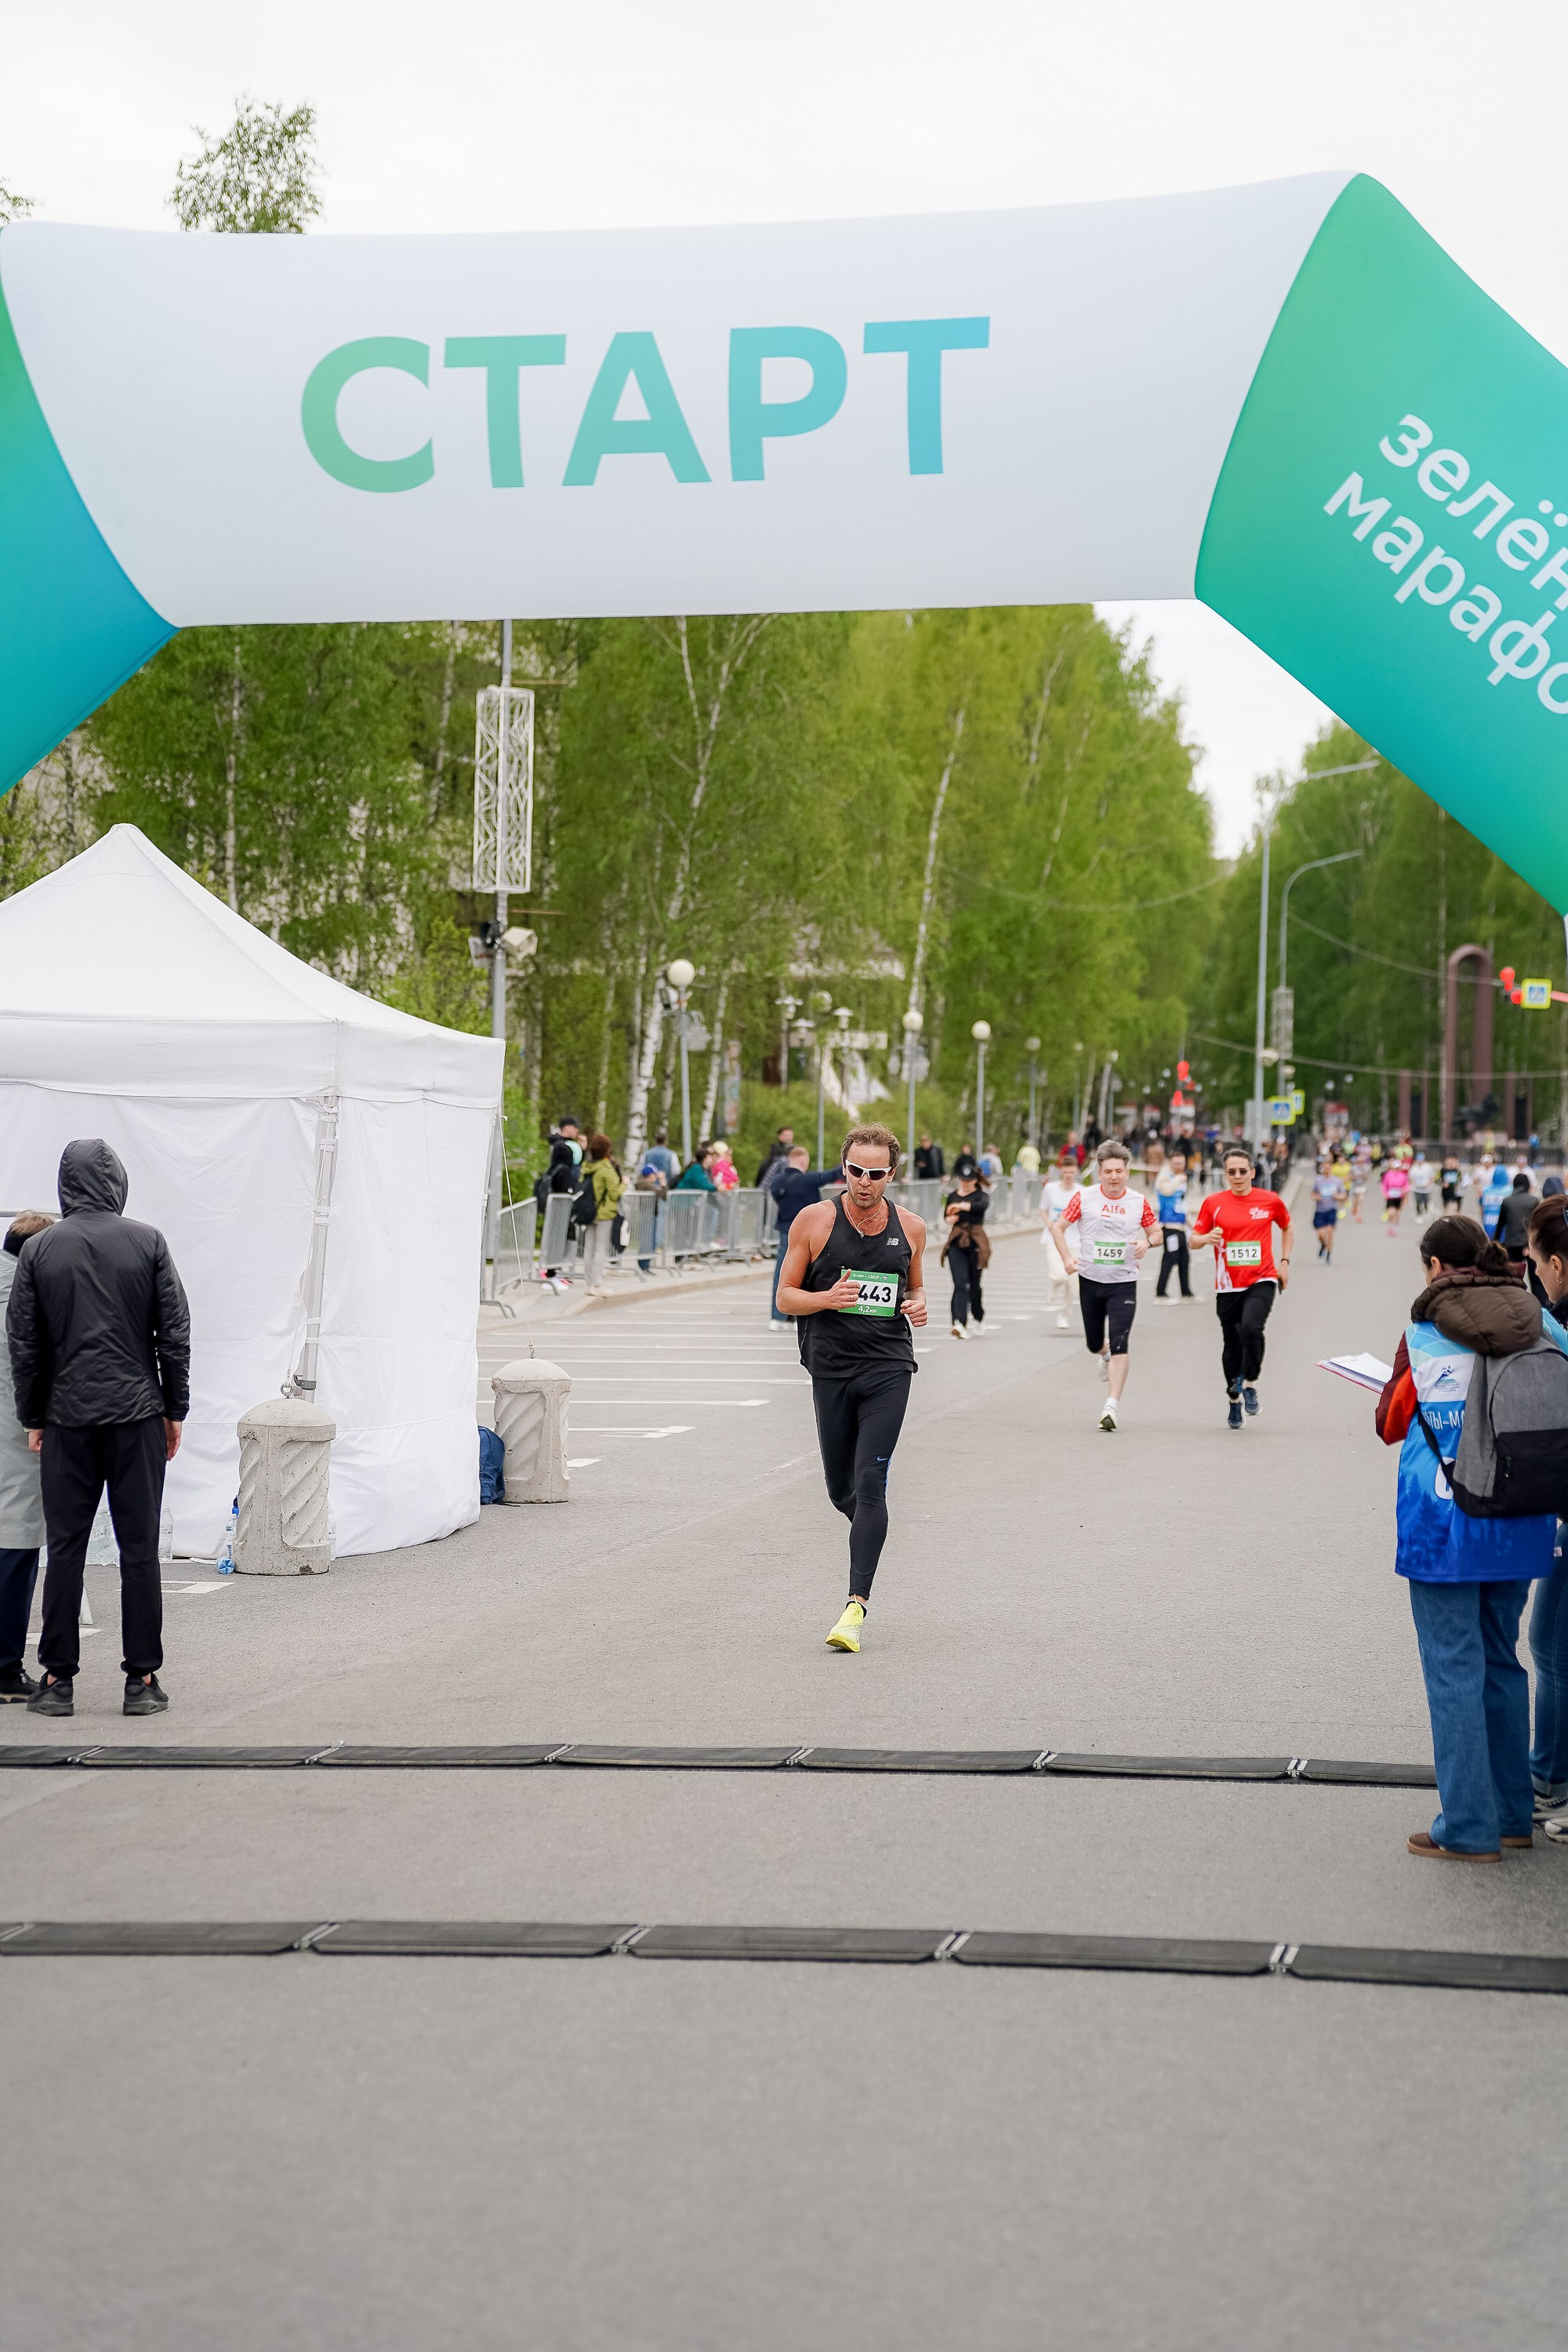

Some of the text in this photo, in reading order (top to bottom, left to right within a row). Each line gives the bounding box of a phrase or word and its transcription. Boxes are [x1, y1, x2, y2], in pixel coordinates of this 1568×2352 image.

[301, 316, 990, 492] СТАРТ
[1102, 1204, 1126, 1214] Alfa
[1098, 1248, 1123, 1258] 1459
[1232, 1249, 1257, 1258] 1512
[858, 1284, 891, 1303] 443
